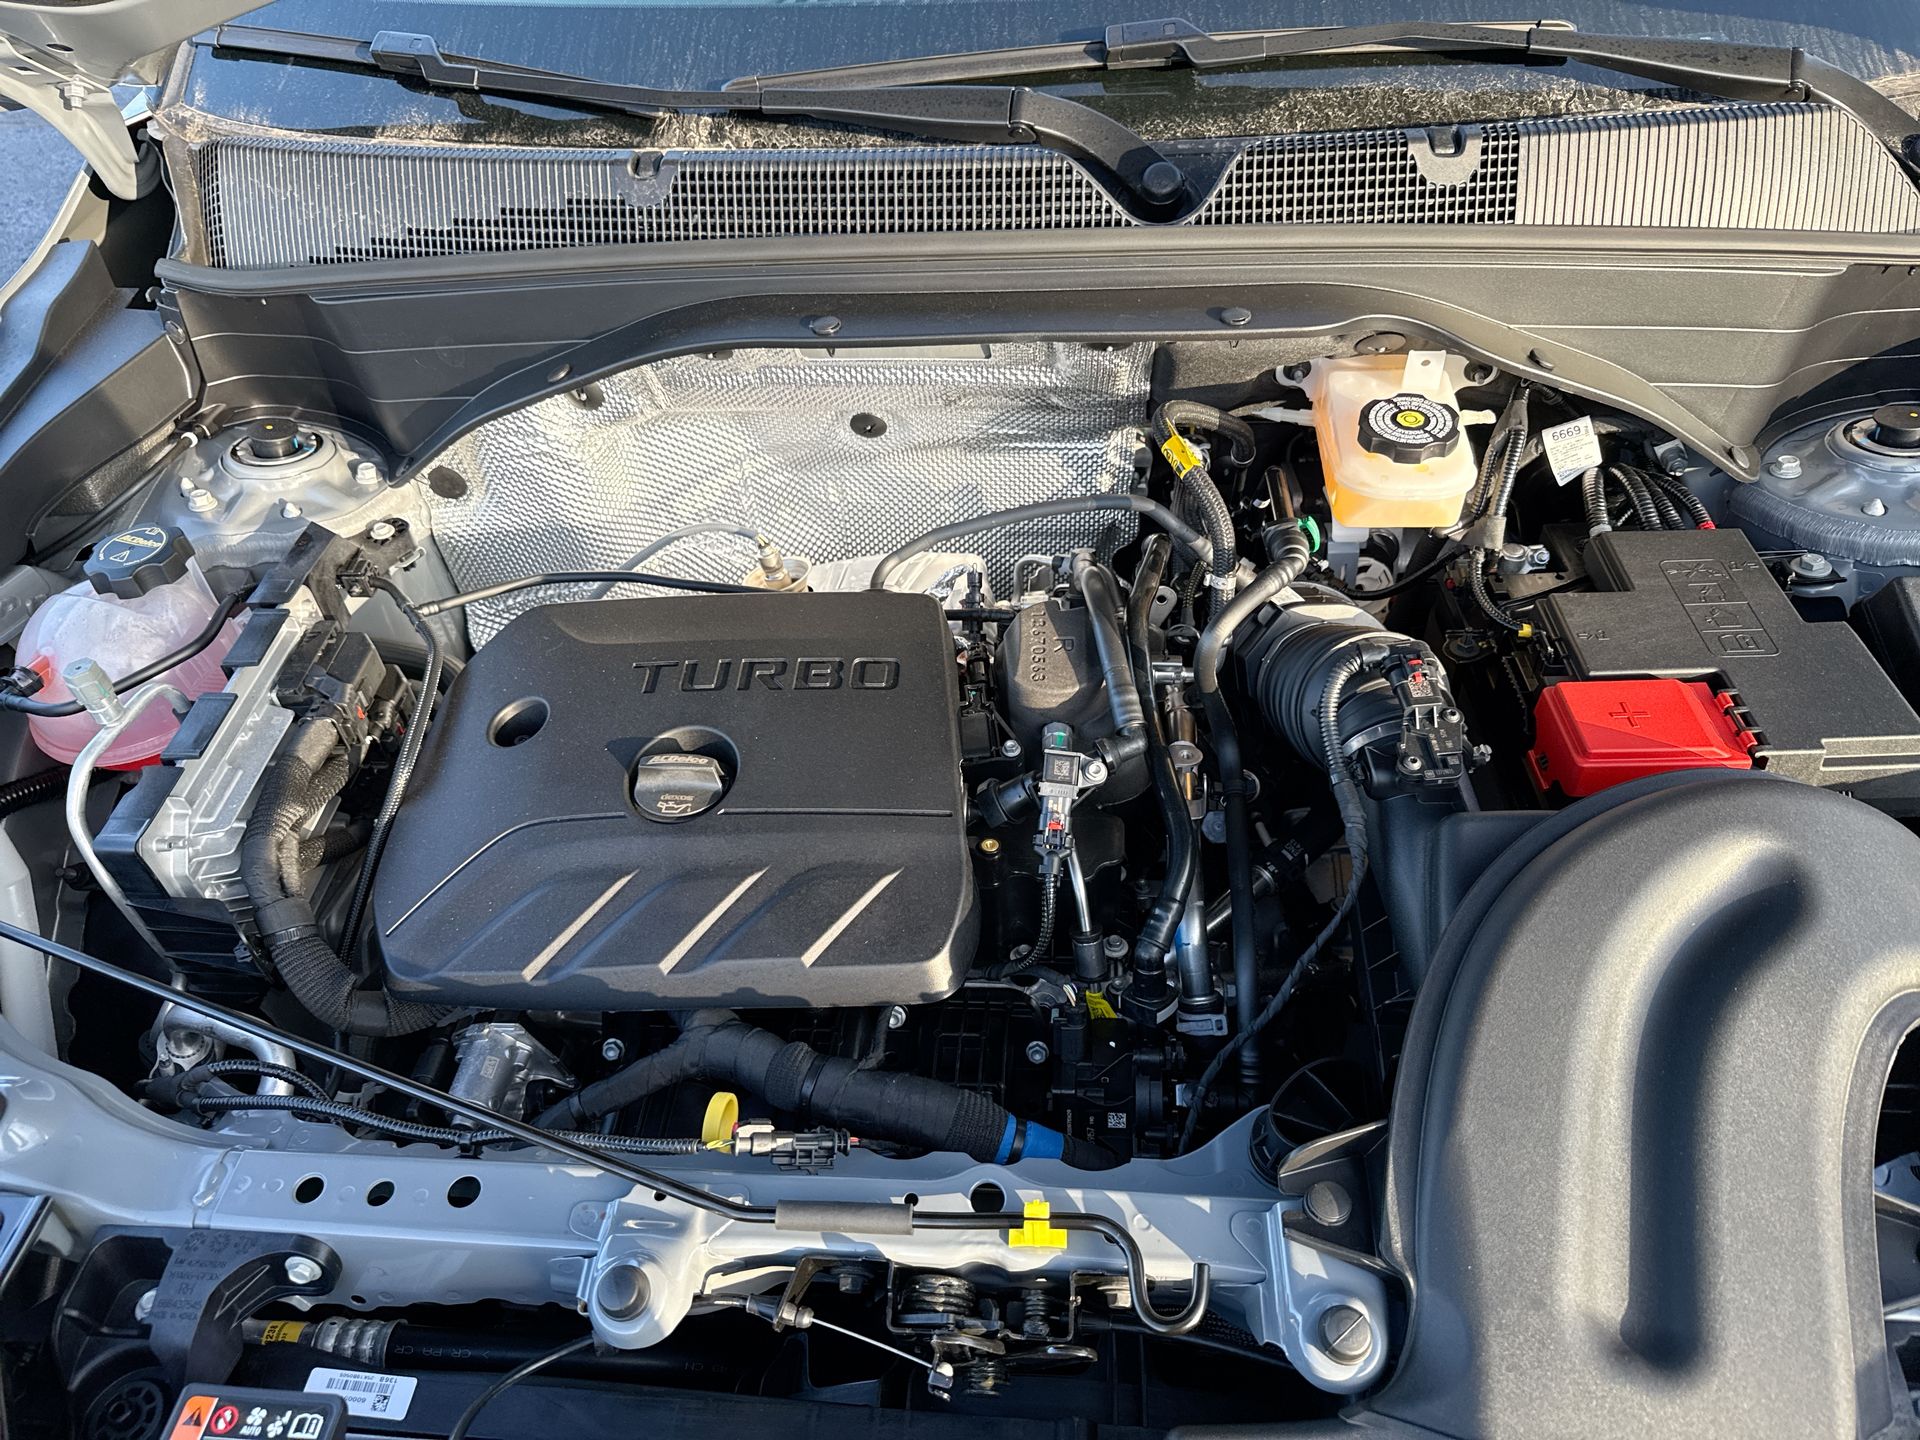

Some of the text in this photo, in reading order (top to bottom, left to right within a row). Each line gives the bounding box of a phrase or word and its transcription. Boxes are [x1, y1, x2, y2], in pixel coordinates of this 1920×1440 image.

[1551, 425, 1581, 441] 6669
[631, 657, 900, 694] TURBO
[647, 755, 709, 765] ACDelco
[660, 793, 695, 801] dexos
[239, 1425, 262, 1437] AUTO
